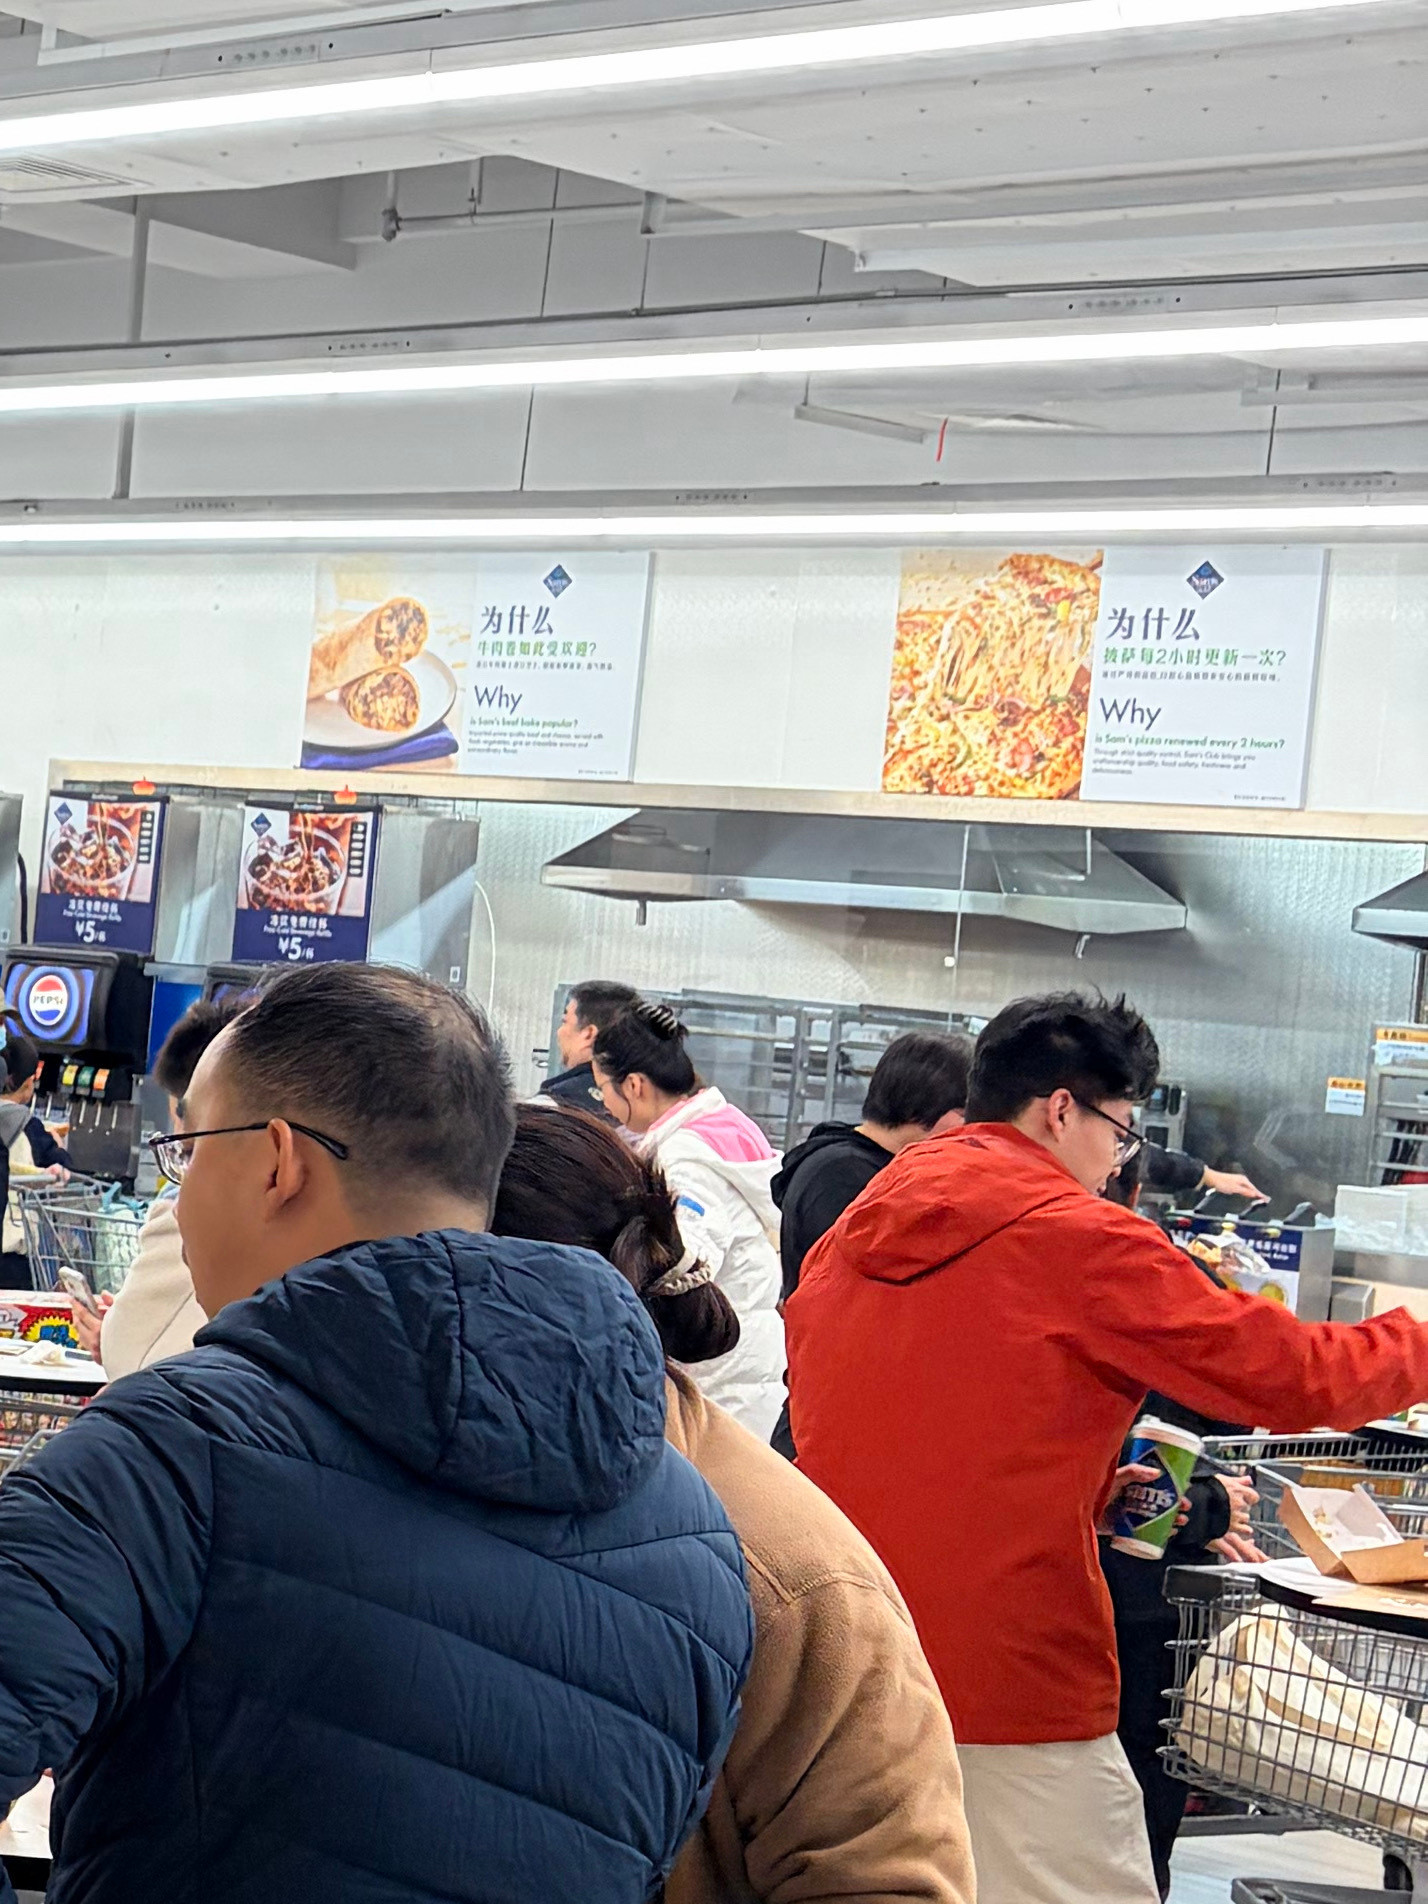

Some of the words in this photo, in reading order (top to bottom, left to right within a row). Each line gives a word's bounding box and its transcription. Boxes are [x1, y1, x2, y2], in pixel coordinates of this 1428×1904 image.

[480, 605, 554, 635] 为什么
[1105, 607, 1200, 640] 为什么
[474, 685, 523, 715] Why
[1100, 697, 1162, 731] Why
[1105, 733, 1133, 745] Sam's
[1135, 734, 1162, 747] pizza
[1164, 736, 1208, 747] renewed
[1210, 739, 1238, 750] every
[1240, 737, 1248, 748] 2
[1250, 737, 1285, 749] hours?
